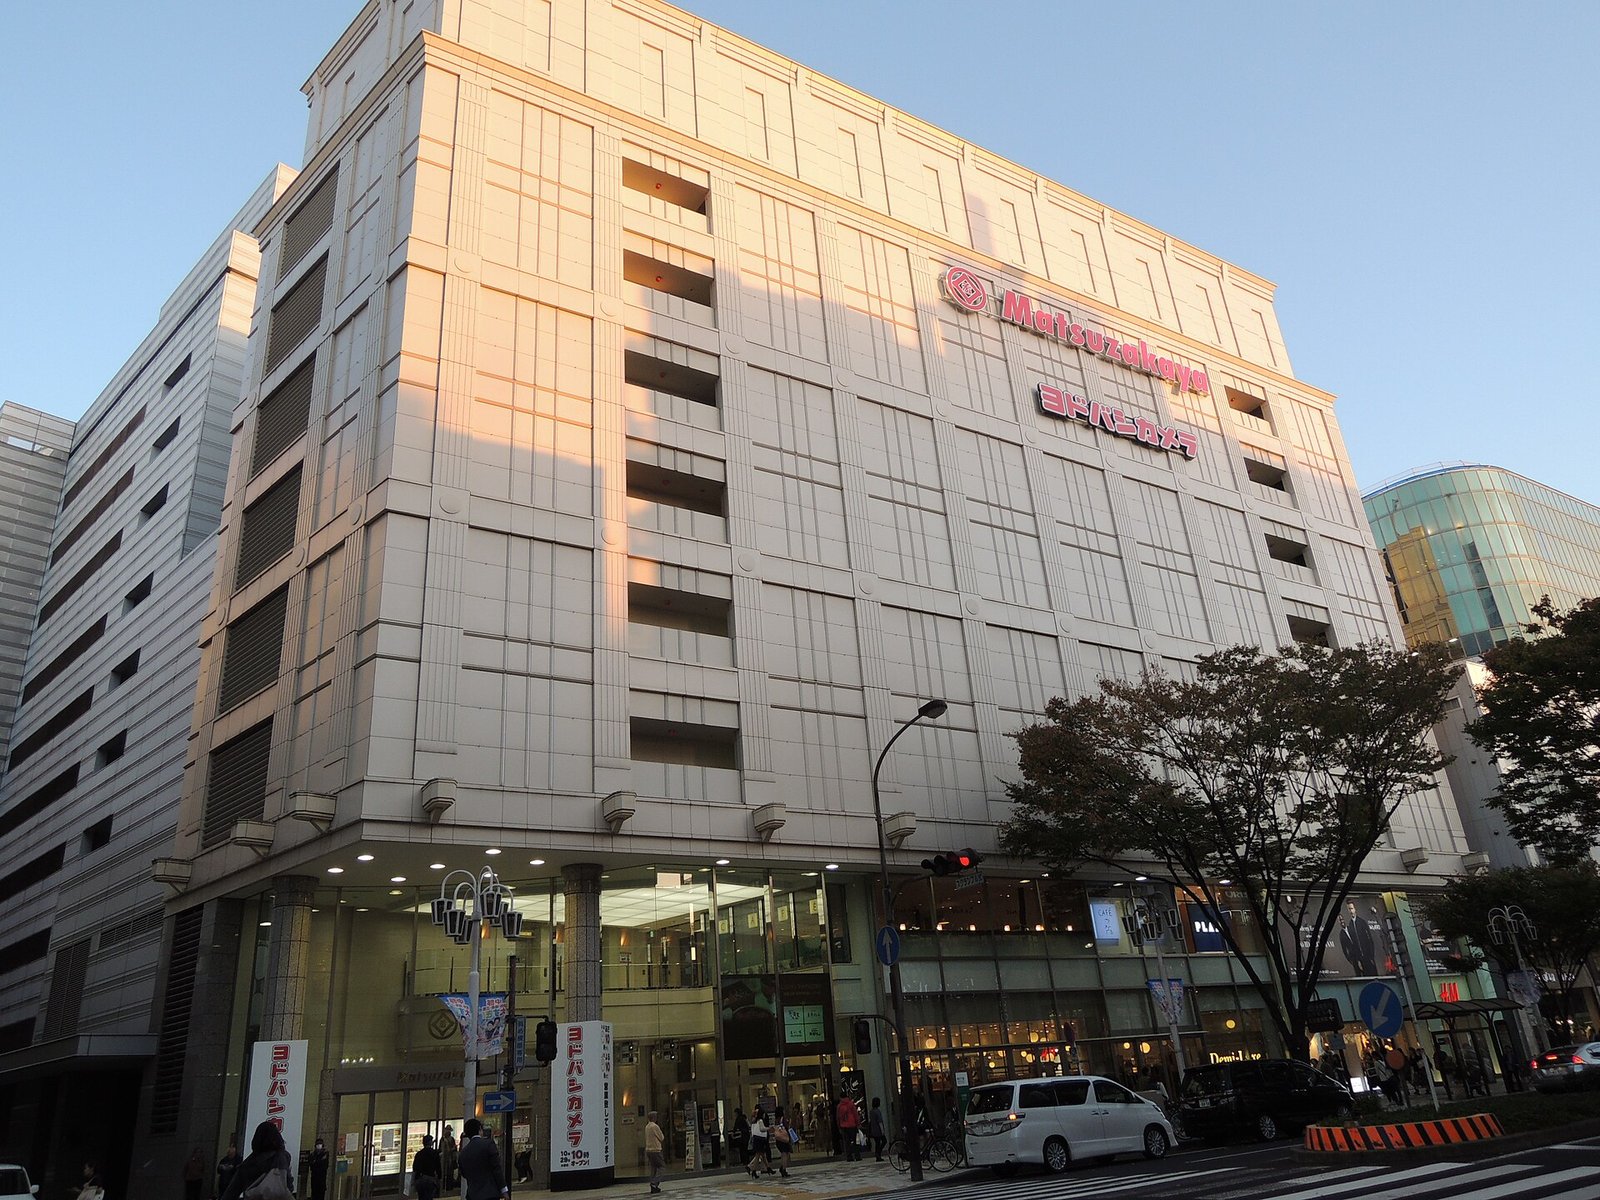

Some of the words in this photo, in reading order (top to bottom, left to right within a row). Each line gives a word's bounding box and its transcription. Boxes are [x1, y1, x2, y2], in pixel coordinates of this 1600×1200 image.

[1001, 289, 1209, 396] Matsuzakaya
[1036, 382, 1198, 459] ヨドバシカメラ
[566, 1026, 584, 1148] ヨドバシカメラ
